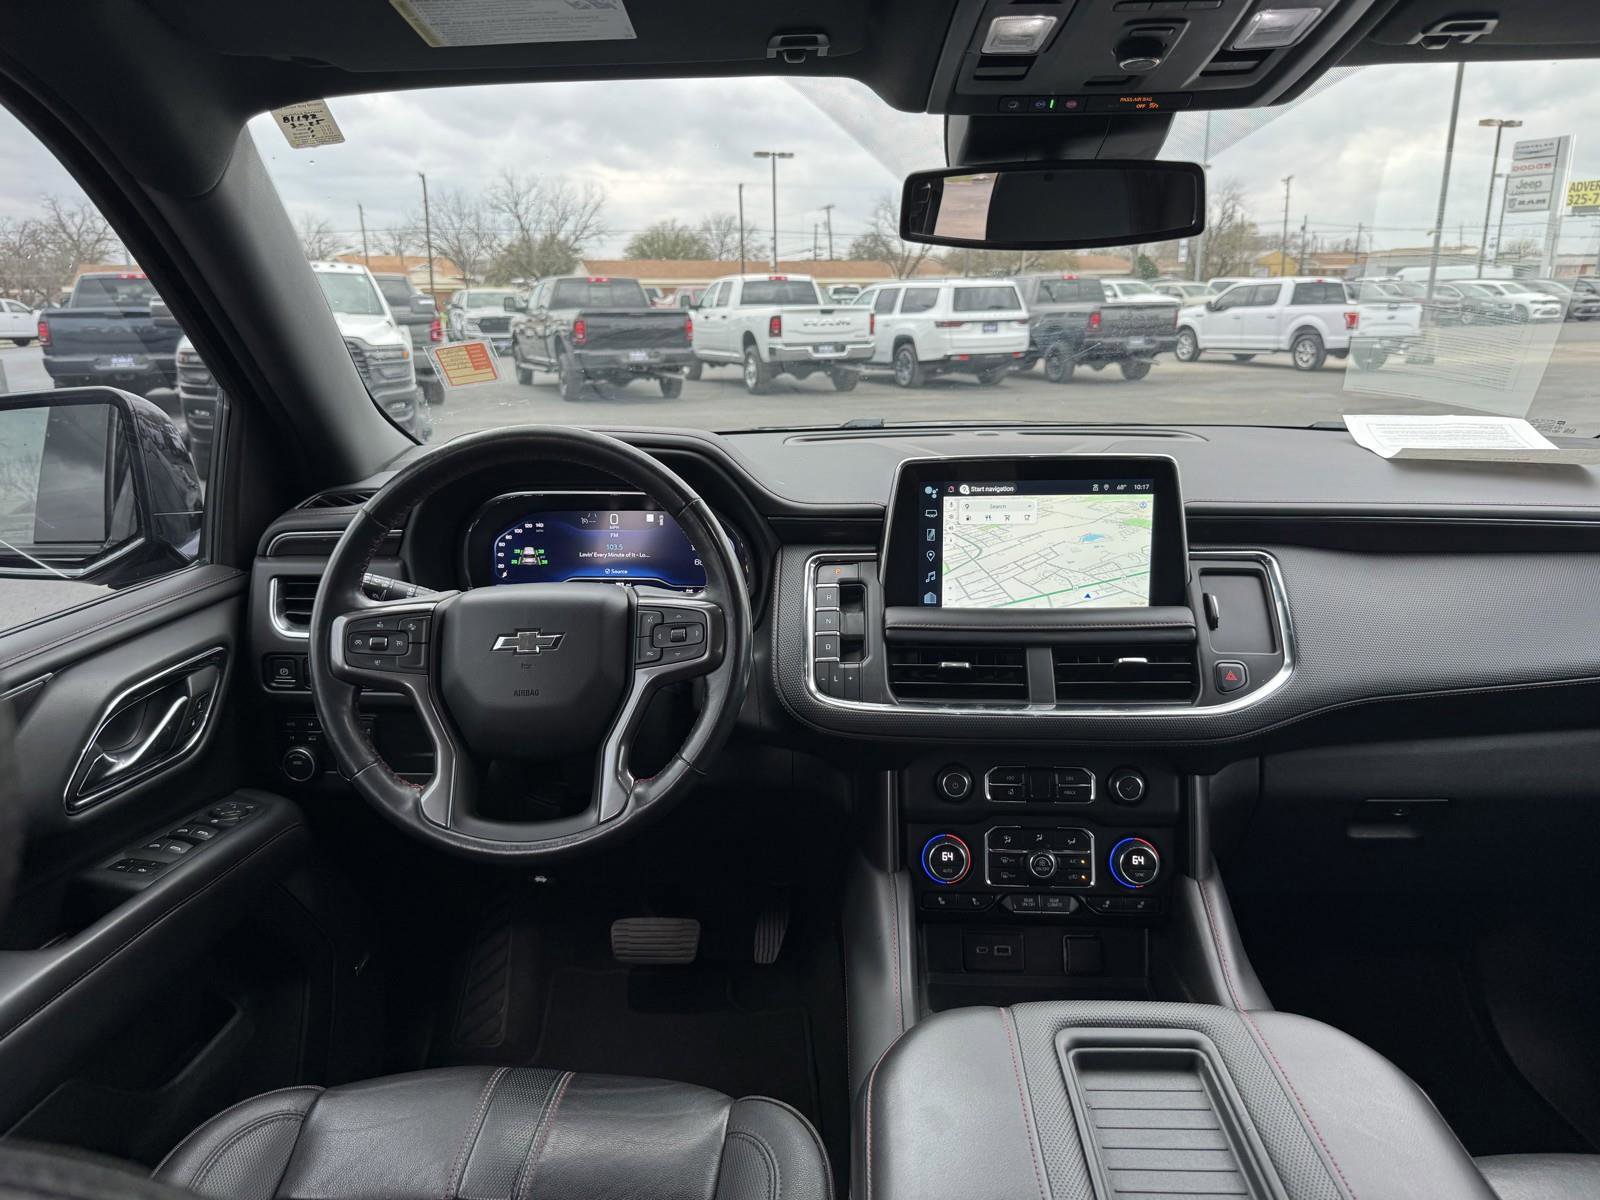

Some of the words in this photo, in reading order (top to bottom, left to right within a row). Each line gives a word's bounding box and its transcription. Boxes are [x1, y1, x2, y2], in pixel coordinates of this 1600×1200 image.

[985, 486, 1014, 494] navigation
[606, 543, 624, 551] 103.5
[513, 689, 540, 697] AIRBAG
[942, 851, 954, 861] 64
[1132, 855, 1145, 866] 64
